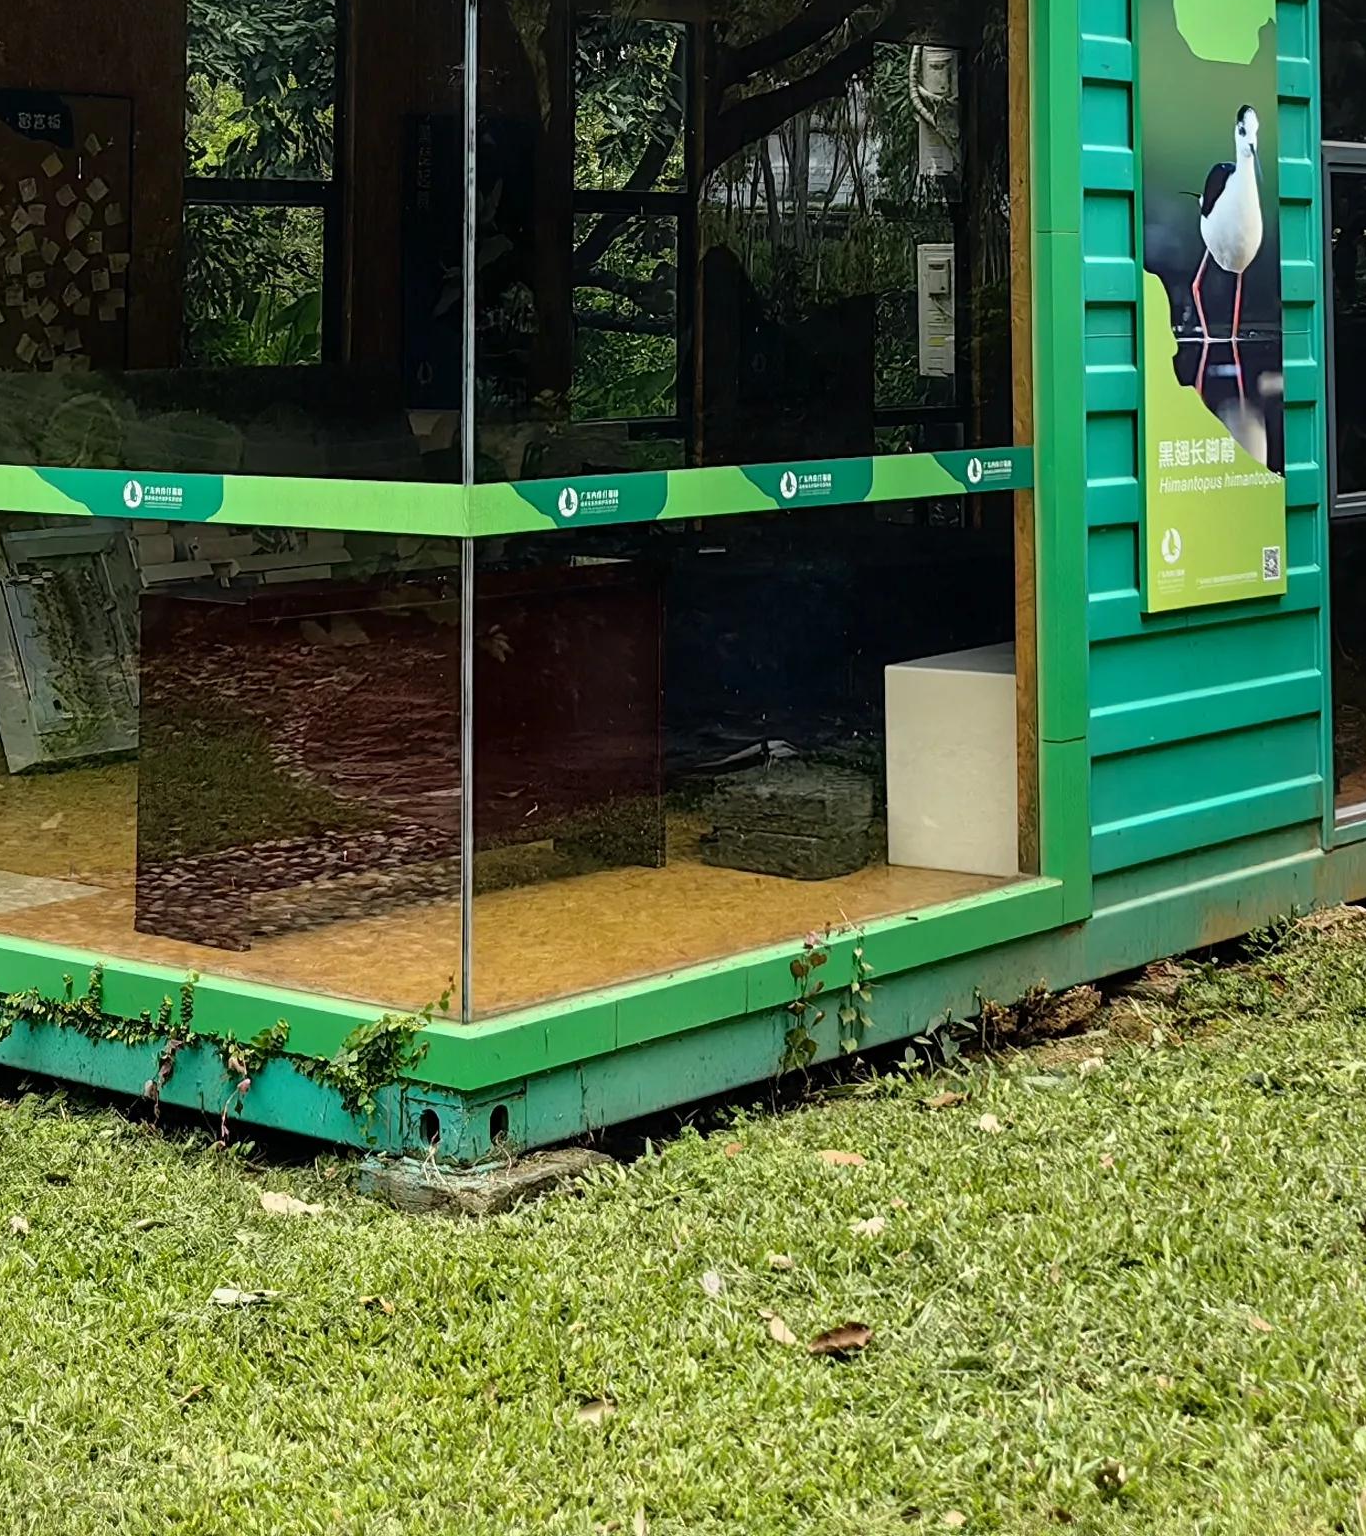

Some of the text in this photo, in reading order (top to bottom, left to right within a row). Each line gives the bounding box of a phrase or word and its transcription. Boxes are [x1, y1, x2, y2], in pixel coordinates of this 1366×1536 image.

[1158, 436, 1236, 469] 黑翅长脚鹬
[1159, 471, 1282, 495] Himantopus himantopus
